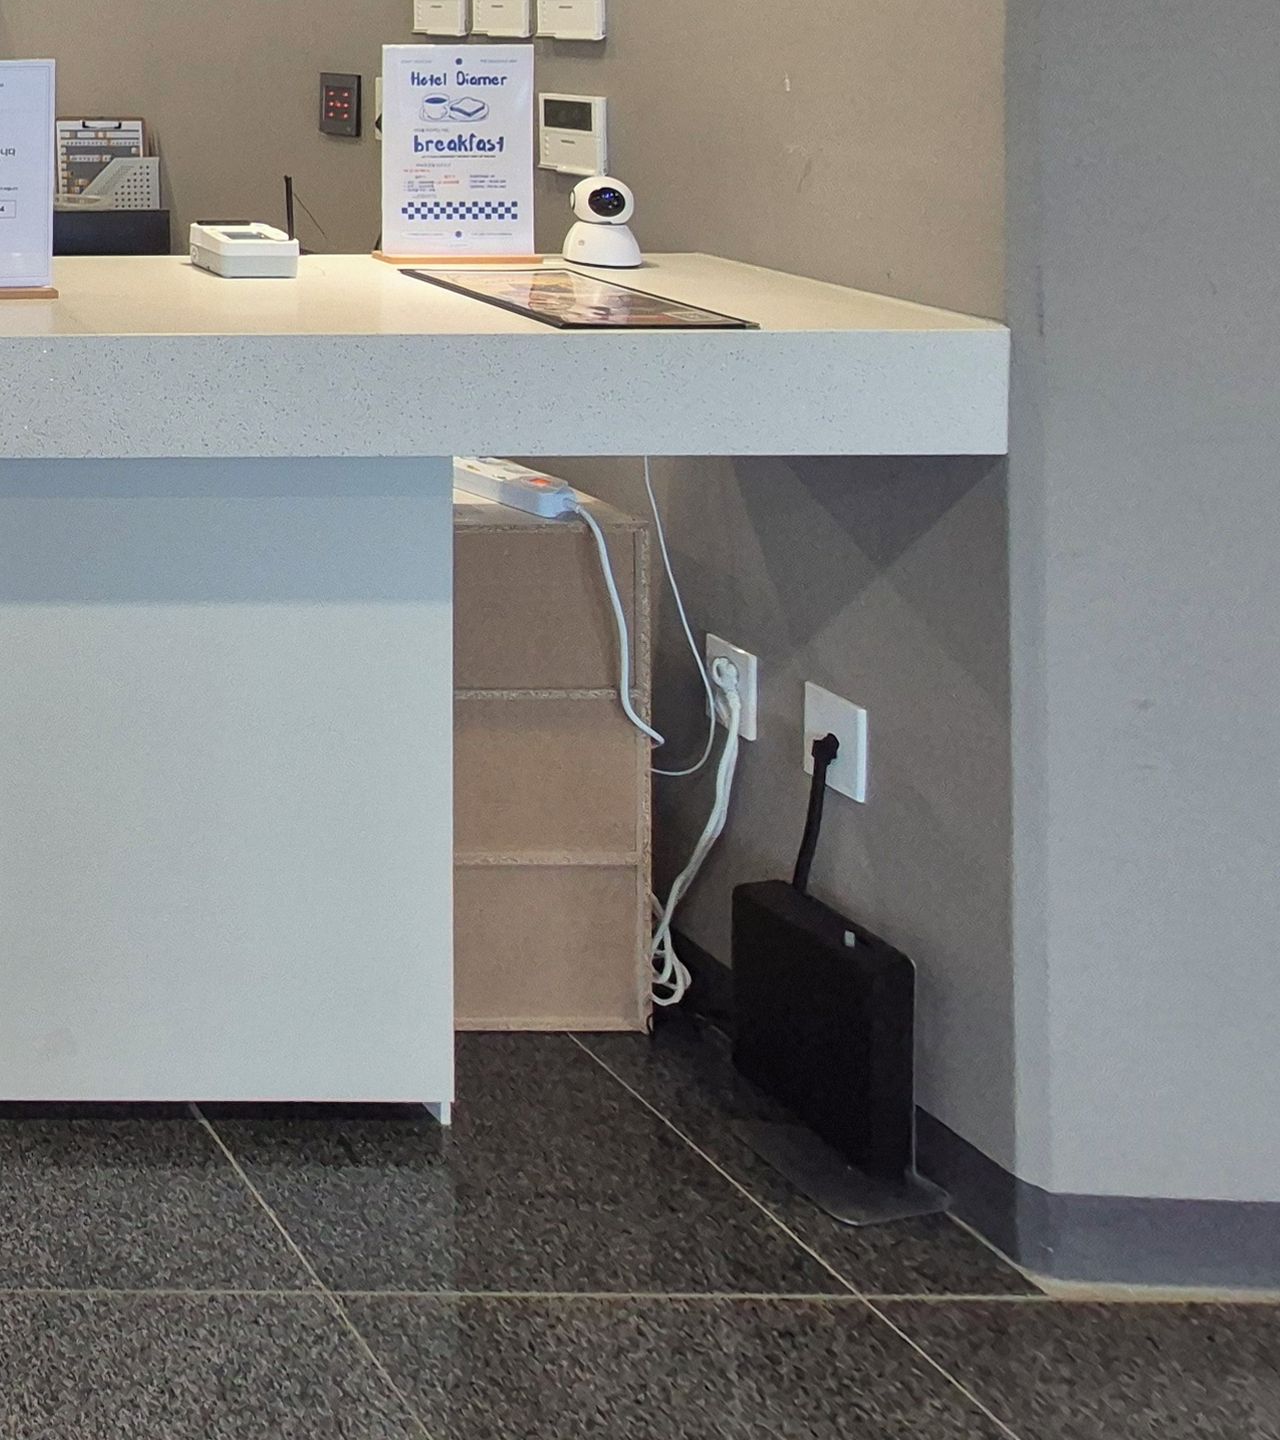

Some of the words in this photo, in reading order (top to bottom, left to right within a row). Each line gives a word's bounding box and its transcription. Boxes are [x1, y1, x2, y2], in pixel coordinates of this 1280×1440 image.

[410, 71, 447, 86] Hotel
[456, 70, 508, 86] Diamer
[413, 133, 505, 153] breakfast
